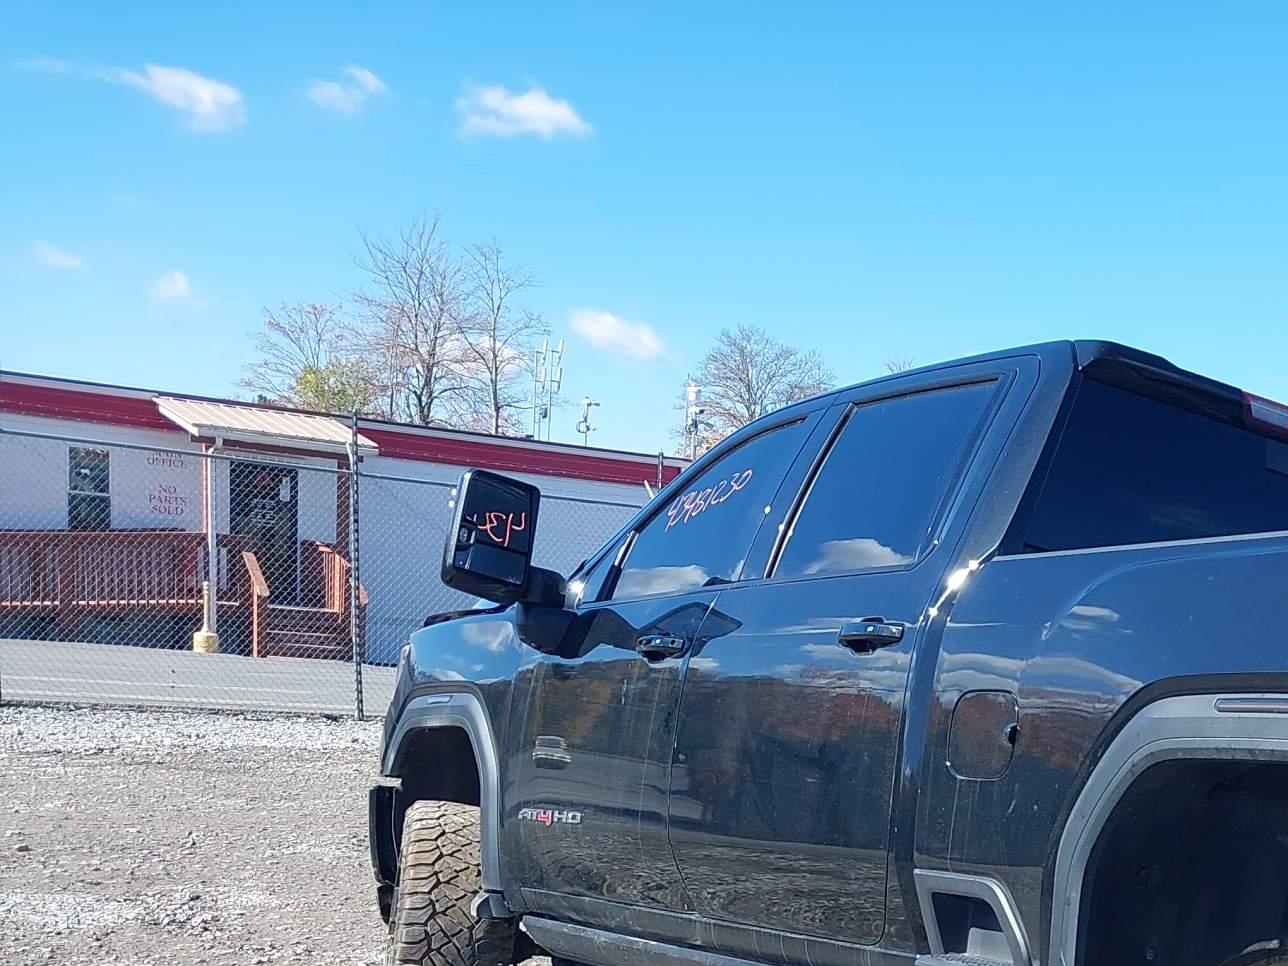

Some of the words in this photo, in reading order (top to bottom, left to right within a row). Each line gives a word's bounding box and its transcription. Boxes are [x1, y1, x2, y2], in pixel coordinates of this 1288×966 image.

[159, 484, 177, 494] NO
[149, 494, 188, 506] PARTS
[151, 504, 184, 516] SOLD
